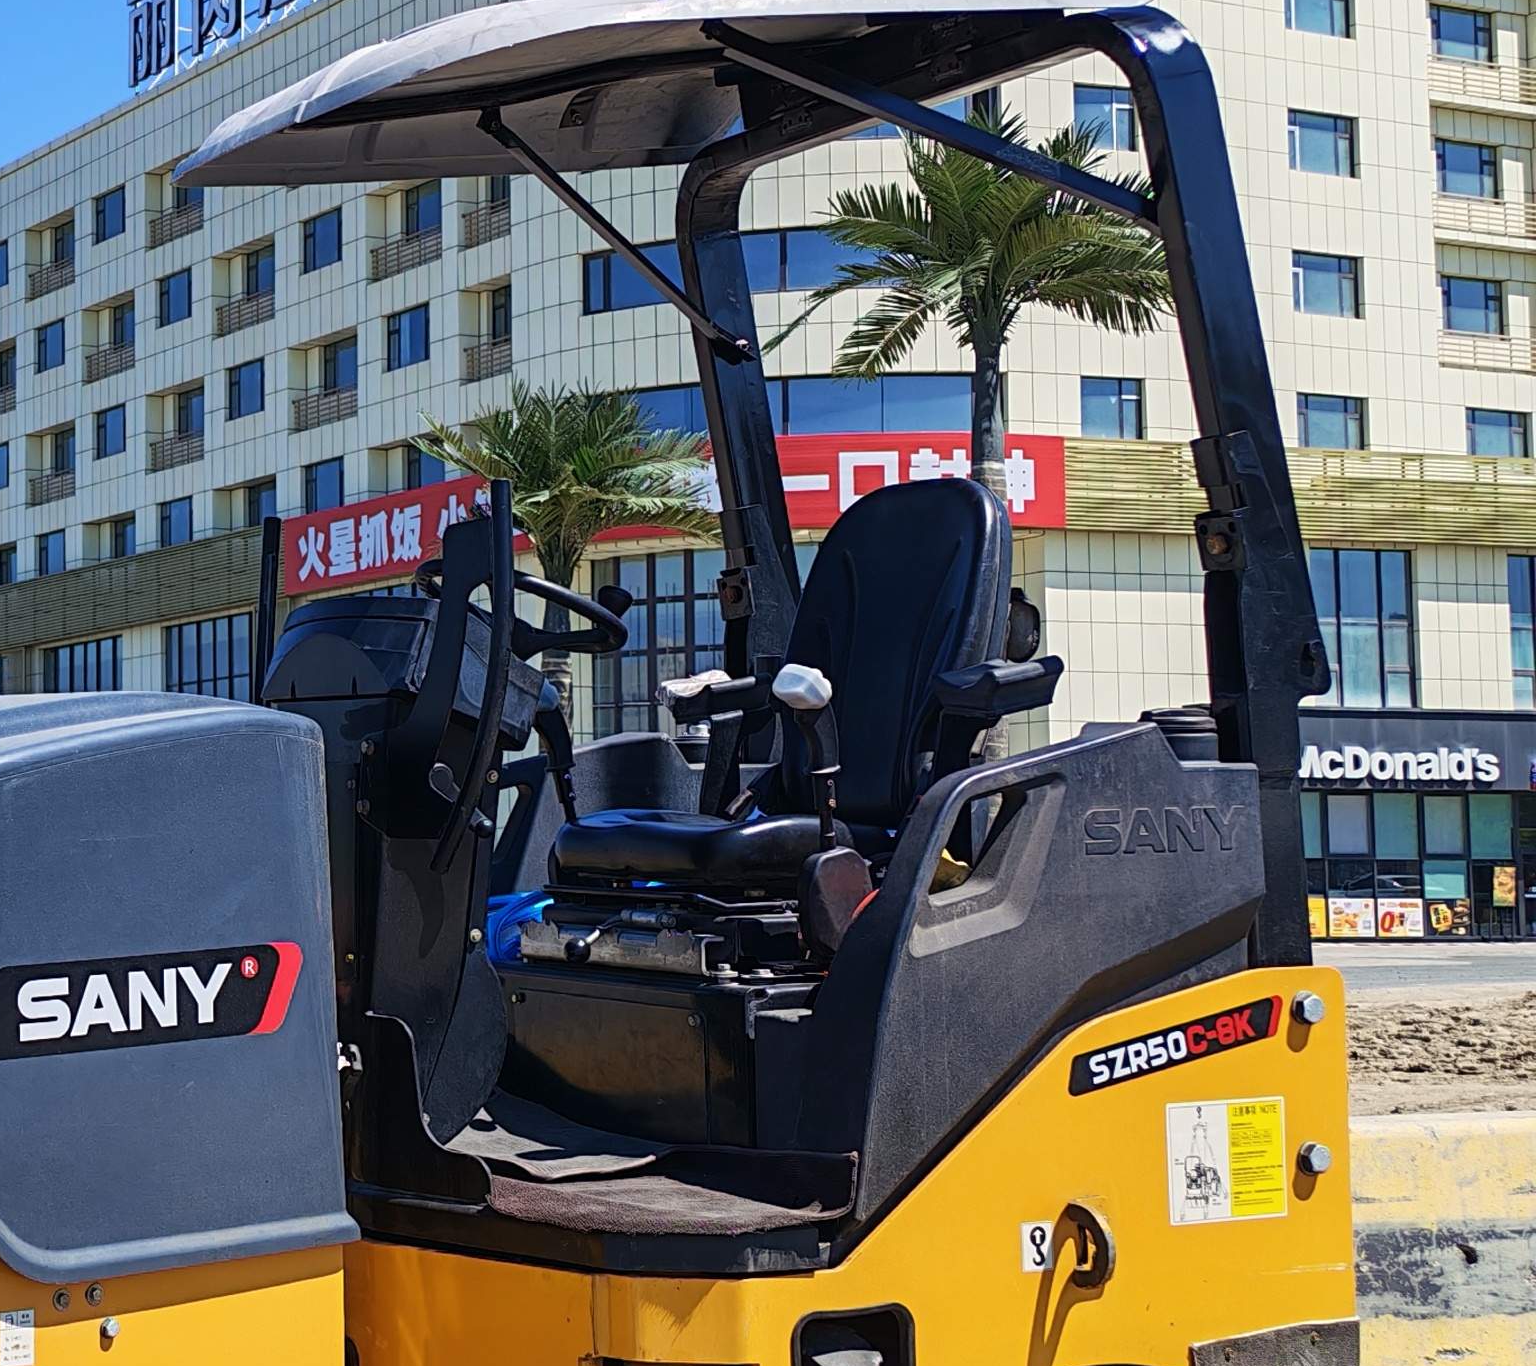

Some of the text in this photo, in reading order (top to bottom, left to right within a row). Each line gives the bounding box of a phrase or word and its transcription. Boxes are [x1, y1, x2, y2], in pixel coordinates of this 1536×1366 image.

[298, 504, 422, 582] 火星抓饭
[1083, 804, 1245, 855] SANY
[17, 962, 233, 1042] SANY
[1088, 1007, 1257, 1085] SZR50C-8K
